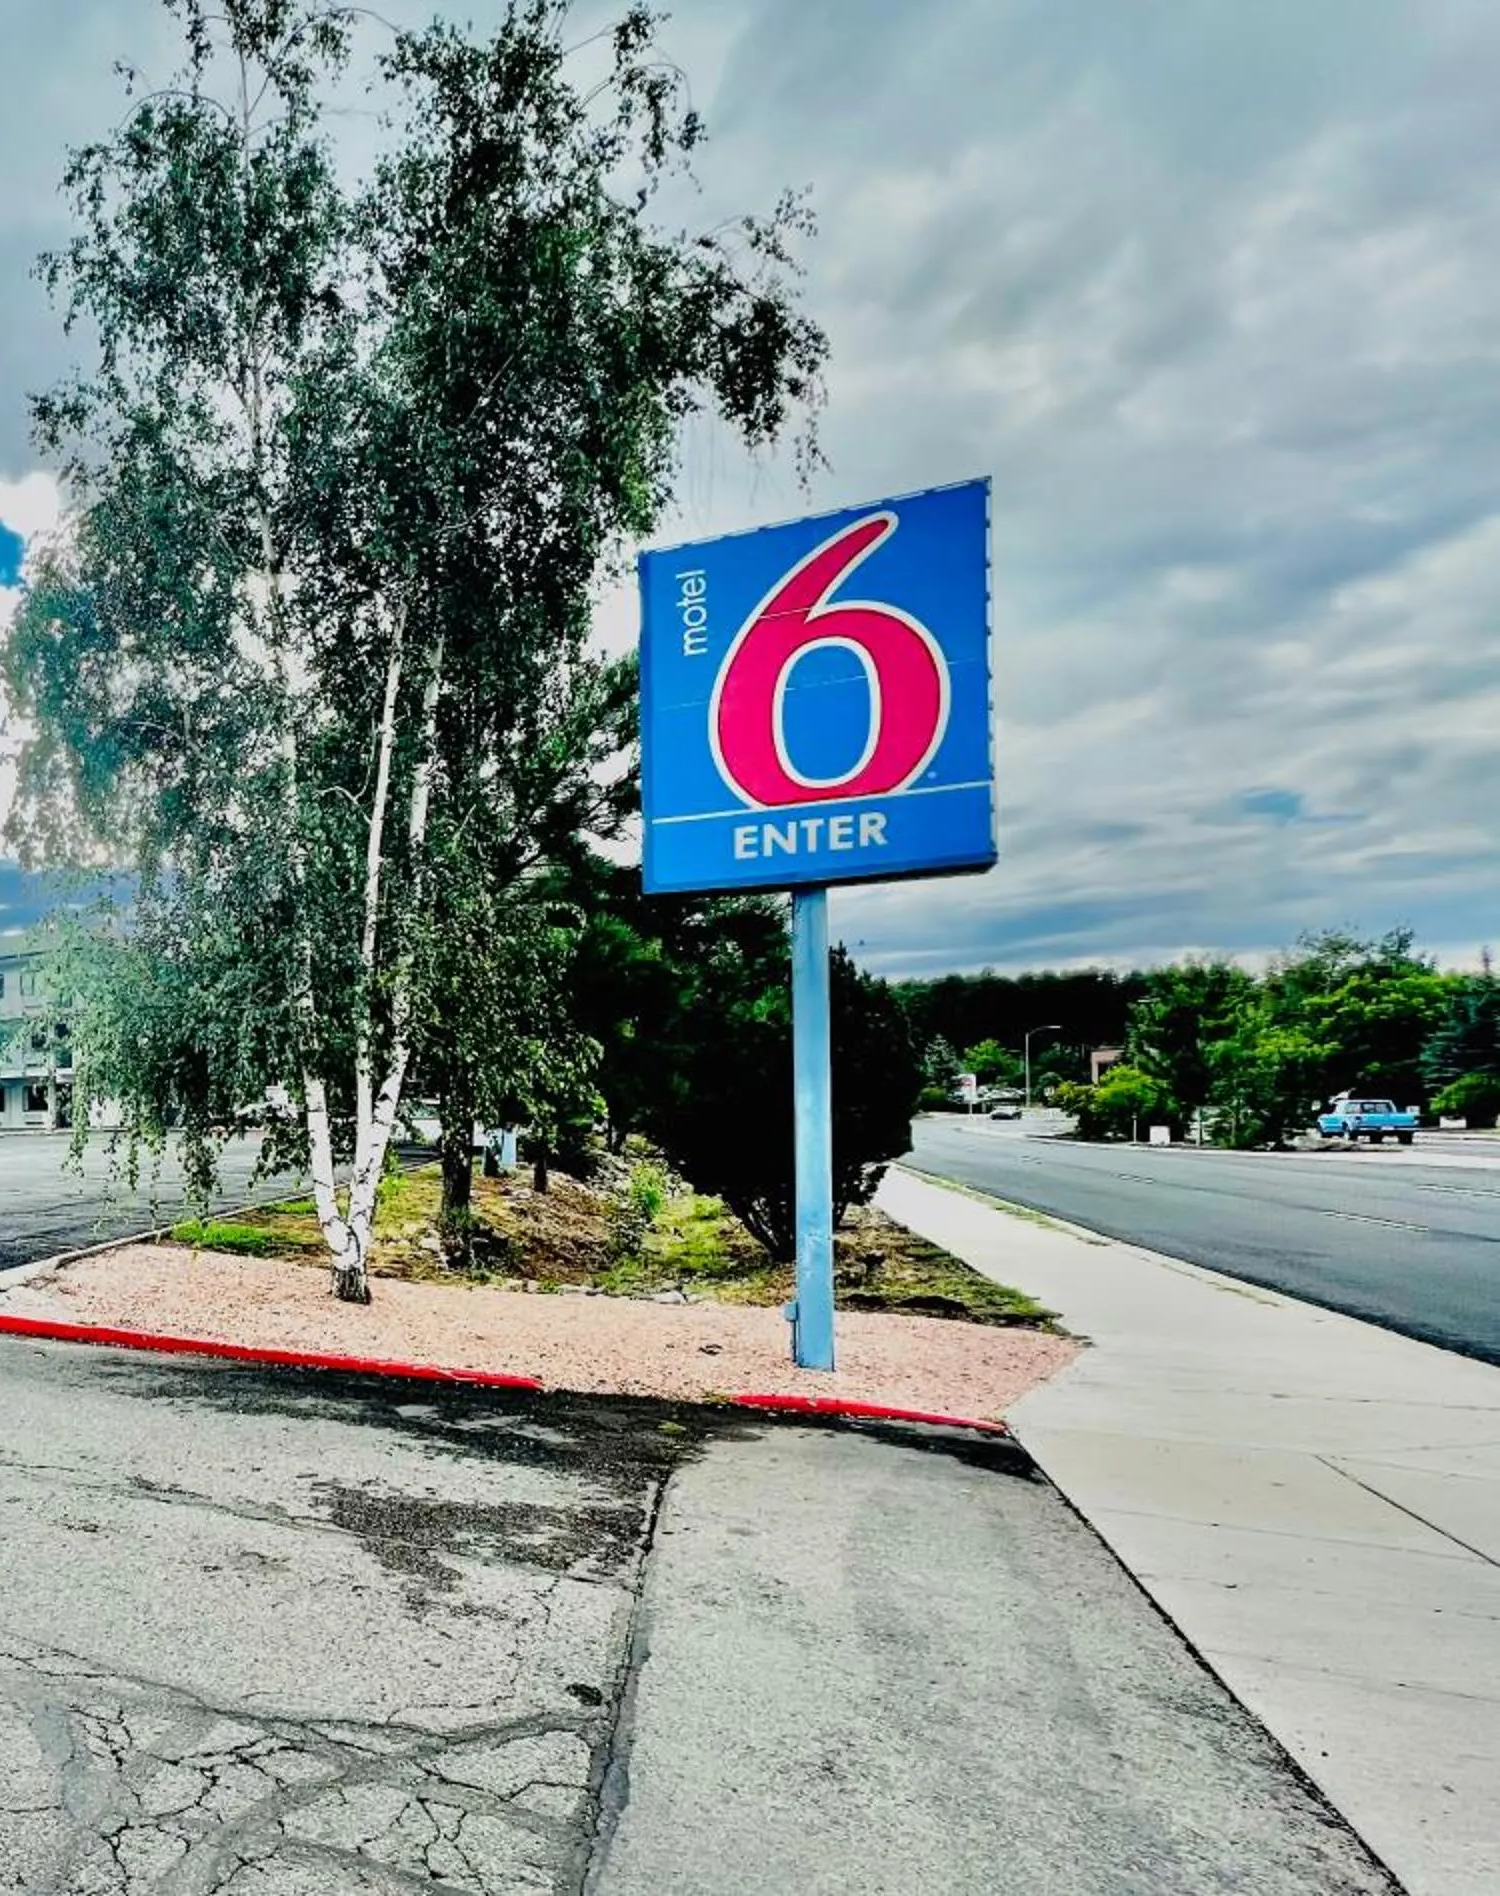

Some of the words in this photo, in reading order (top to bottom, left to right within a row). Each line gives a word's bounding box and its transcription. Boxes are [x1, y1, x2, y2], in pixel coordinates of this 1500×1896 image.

[675, 569, 708, 657] motel
[708, 511, 951, 809] 6
[734, 811, 888, 859] ENTER
